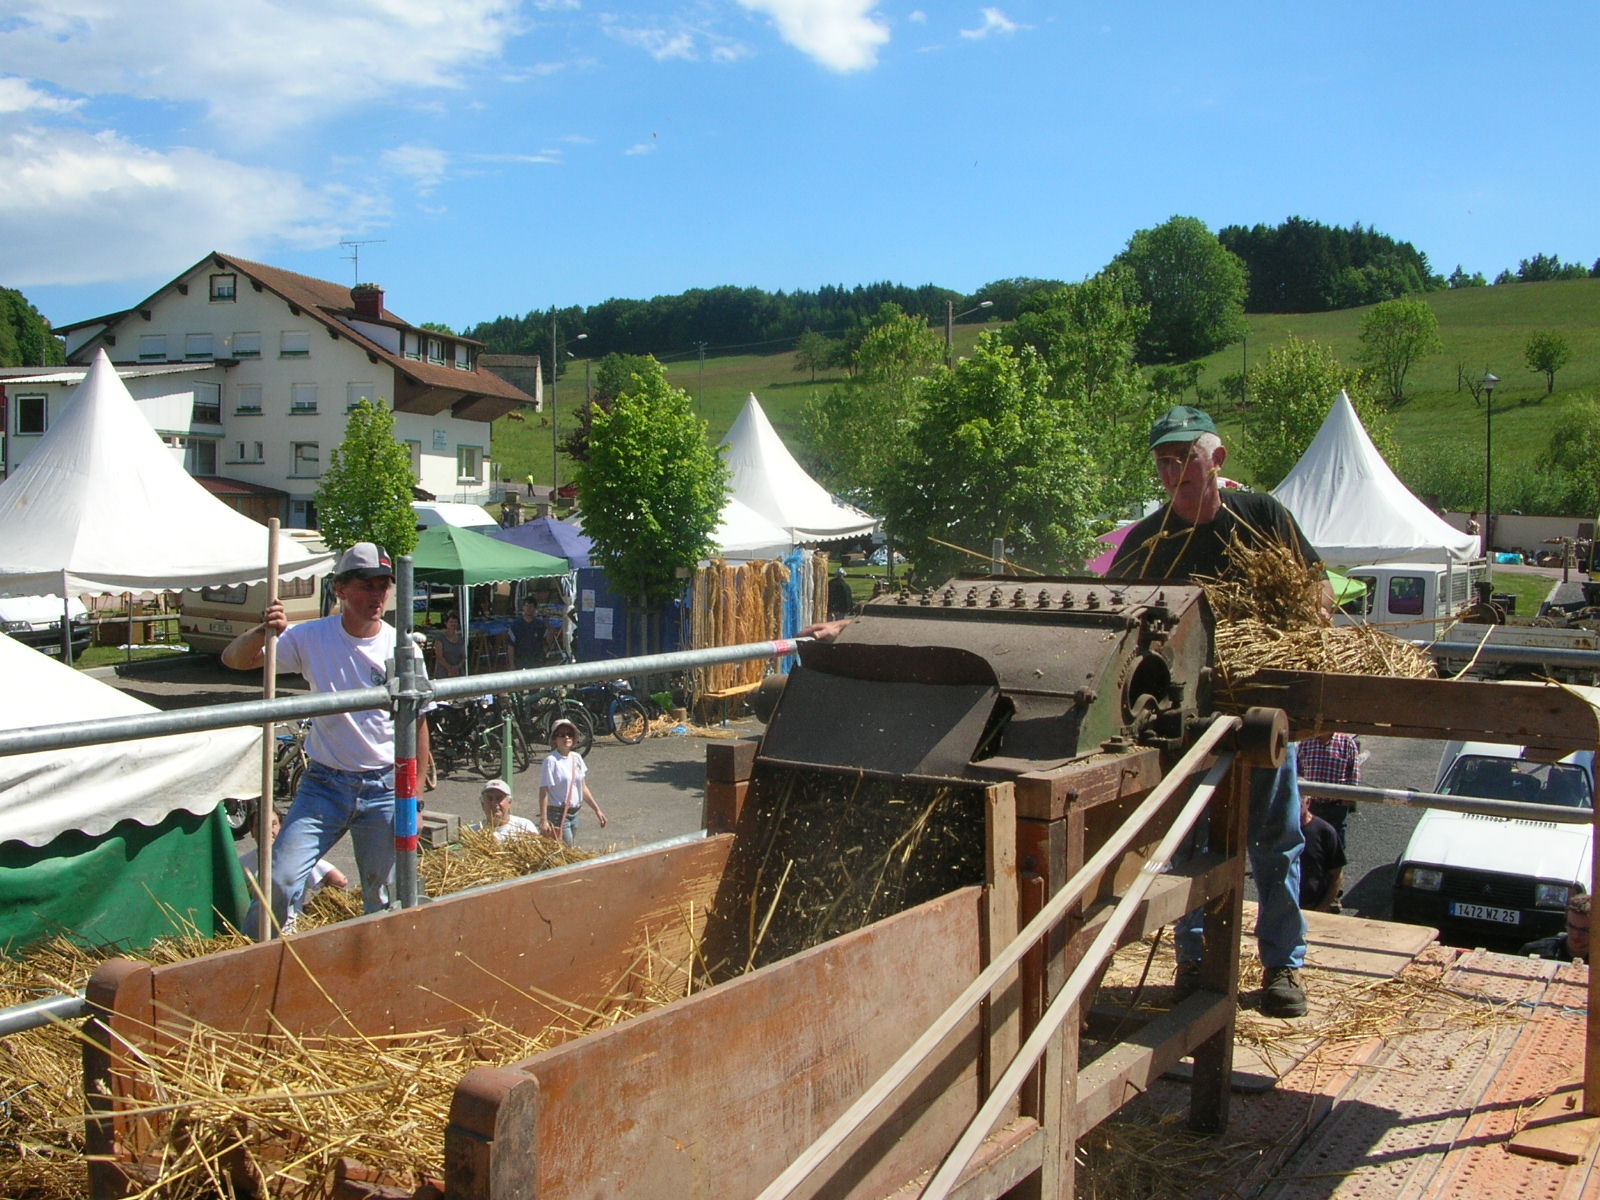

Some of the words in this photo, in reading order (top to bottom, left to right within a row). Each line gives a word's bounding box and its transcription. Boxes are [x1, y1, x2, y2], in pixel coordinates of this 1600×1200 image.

[1458, 904, 1483, 918] 1472
[1486, 908, 1499, 921] WZ
[1502, 911, 1515, 923] 25
